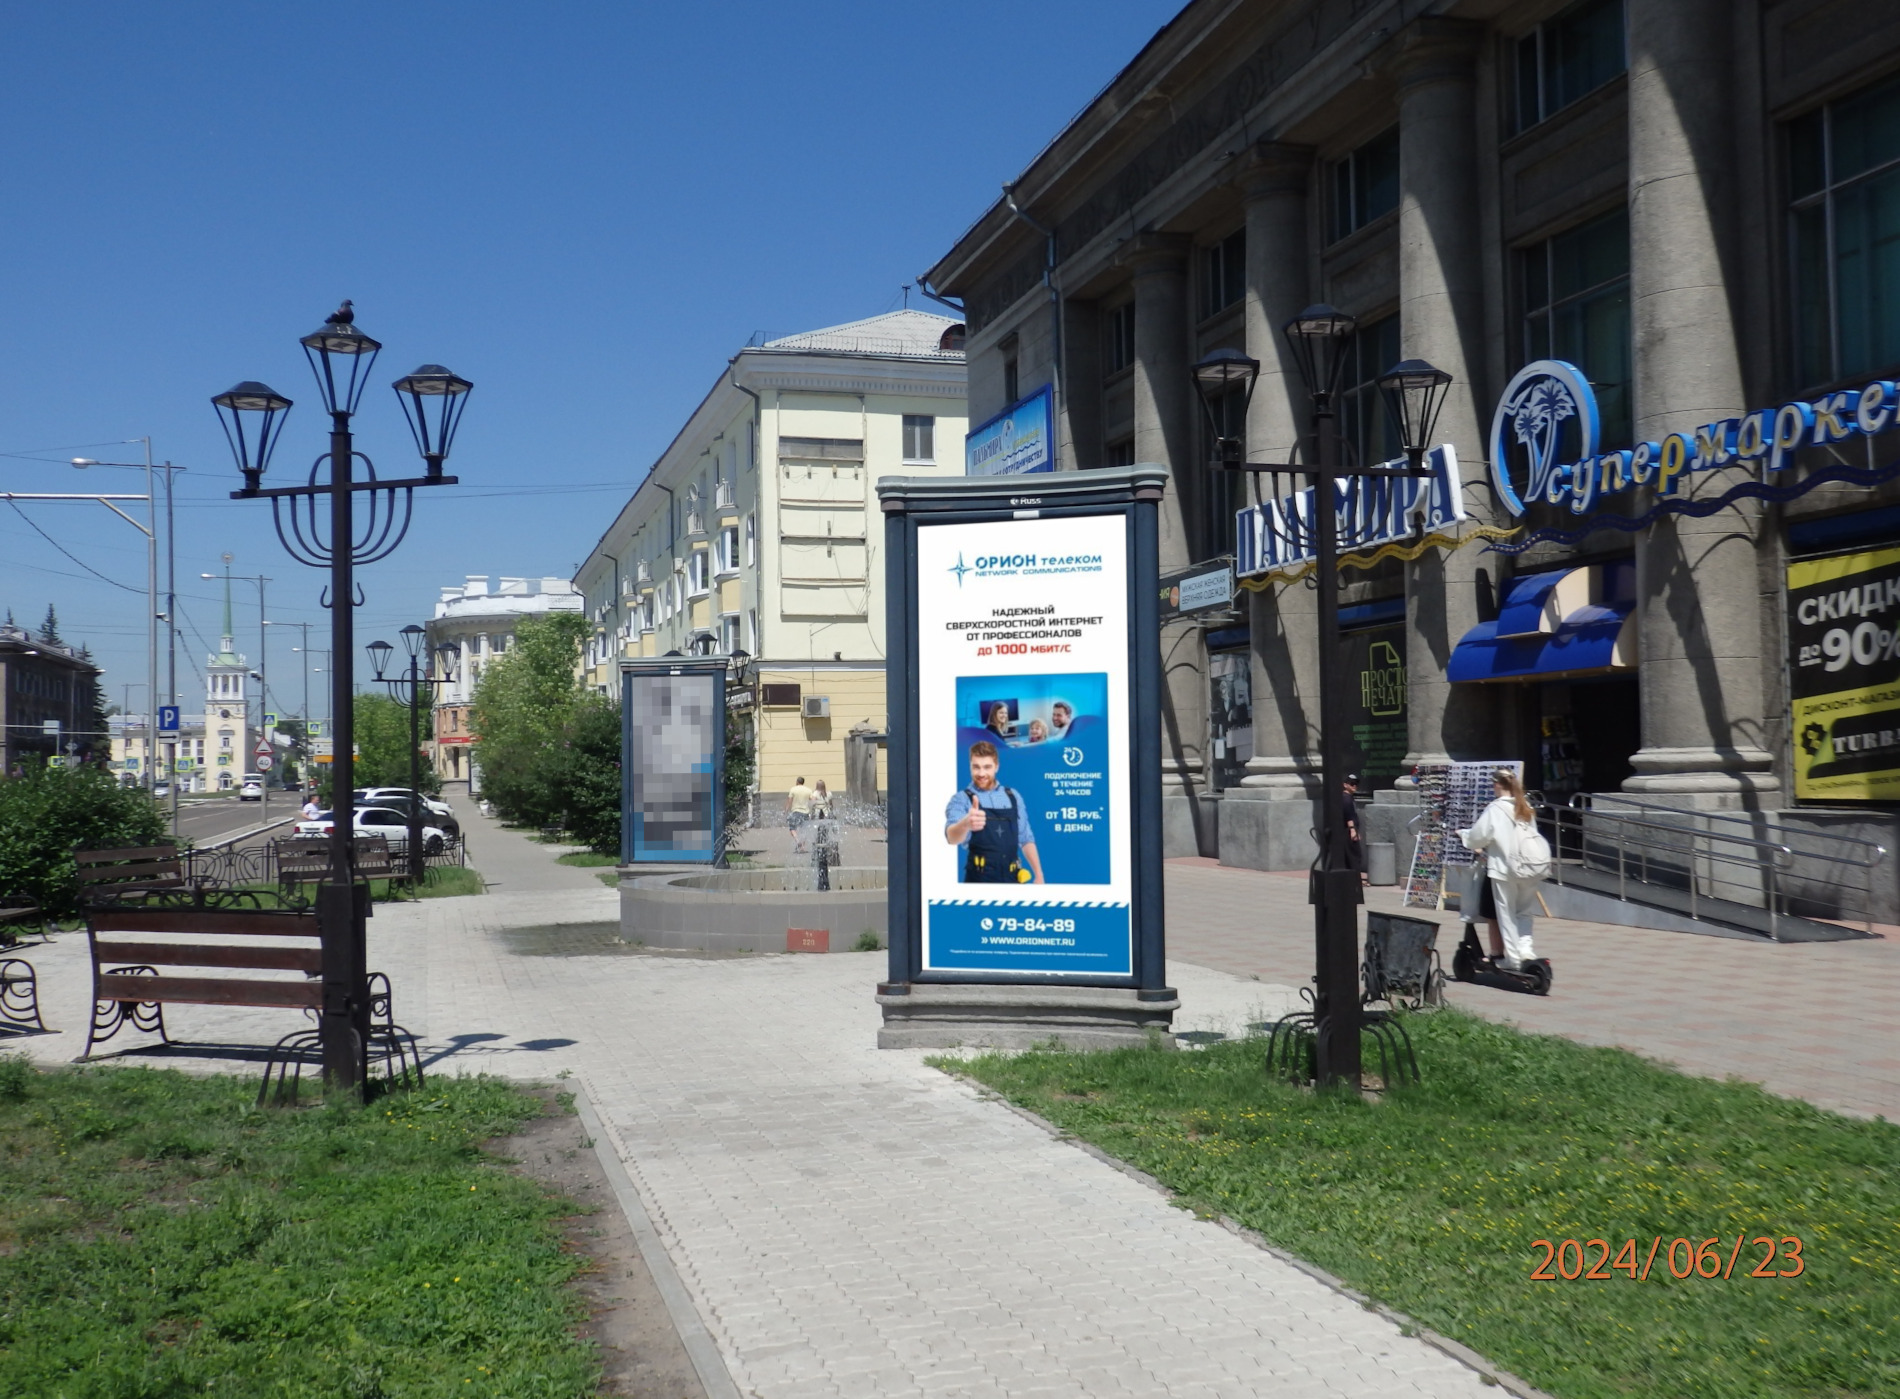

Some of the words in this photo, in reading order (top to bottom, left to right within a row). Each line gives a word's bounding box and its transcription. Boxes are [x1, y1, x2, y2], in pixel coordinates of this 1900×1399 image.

[1546, 378, 1900, 515] супермарке
[975, 553, 1037, 570] ОРИОН
[1040, 554, 1102, 566] телеком
[975, 569, 1018, 577] NETWORK
[1022, 565, 1102, 575] COMMUNICATIONS
[992, 605, 1055, 617] НАДЕЖНЫЙ
[946, 617, 1046, 631] СВЕРХСКОРОСТНОЙ
[1049, 616, 1104, 627] ИНТЕРНЕТ
[966, 632, 980, 641] ОТ
[983, 629, 1082, 641] ПРОФЕССИОНАЛОВ
[977, 646, 992, 657] ДО
[995, 643, 1028, 655] 1000
[1030, 644, 1072, 654] МБИТ/С
[1822, 621, 1900, 672] 90%
[1361, 667, 1408, 690] ПРОСТО
[164, 709, 175, 728] P
[259, 759, 270, 767] 40
[1044, 772, 1102, 780] ПОДКЛЮЧЕНИЕ
[1045, 811, 1059, 820] ОТ
[1061, 807, 1078, 820] 18
[1054, 823, 1062, 832] В
[1063, 823, 1094, 833] ДЕНЬ!
[997, 918, 1076, 932] 79-84-89
[990, 936, 1076, 947] WWW.ORIONNET.RU
